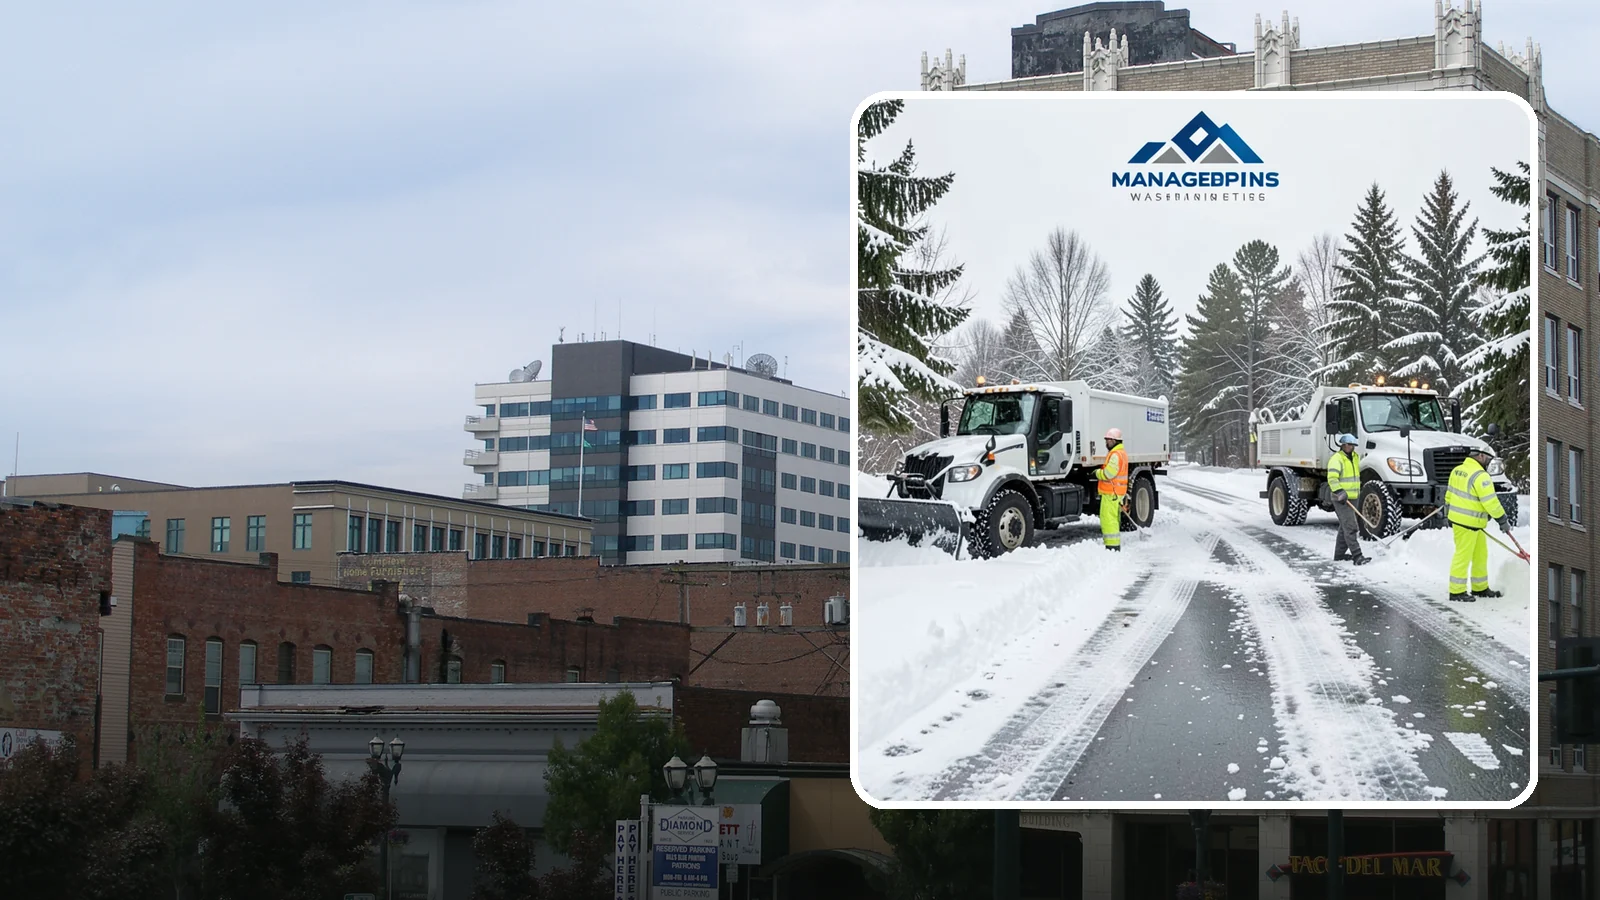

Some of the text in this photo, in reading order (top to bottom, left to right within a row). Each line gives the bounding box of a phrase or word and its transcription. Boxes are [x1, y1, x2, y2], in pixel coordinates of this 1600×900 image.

[343, 566, 427, 577] Home Furnishers
[660, 818, 713, 832] DIAMOND
[1022, 815, 1069, 827] BUILDING
[656, 845, 688, 853] RESERVED
[616, 825, 625, 893] PAY HERE
[722, 852, 739, 861] Soup
[671, 862, 701, 870] PATRONS
[1345, 855, 1385, 875] DEL
[1391, 857, 1442, 876] MAR
[628, 856, 636, 893] HERE
[661, 889, 710, 898] PUBLIC PARKING
